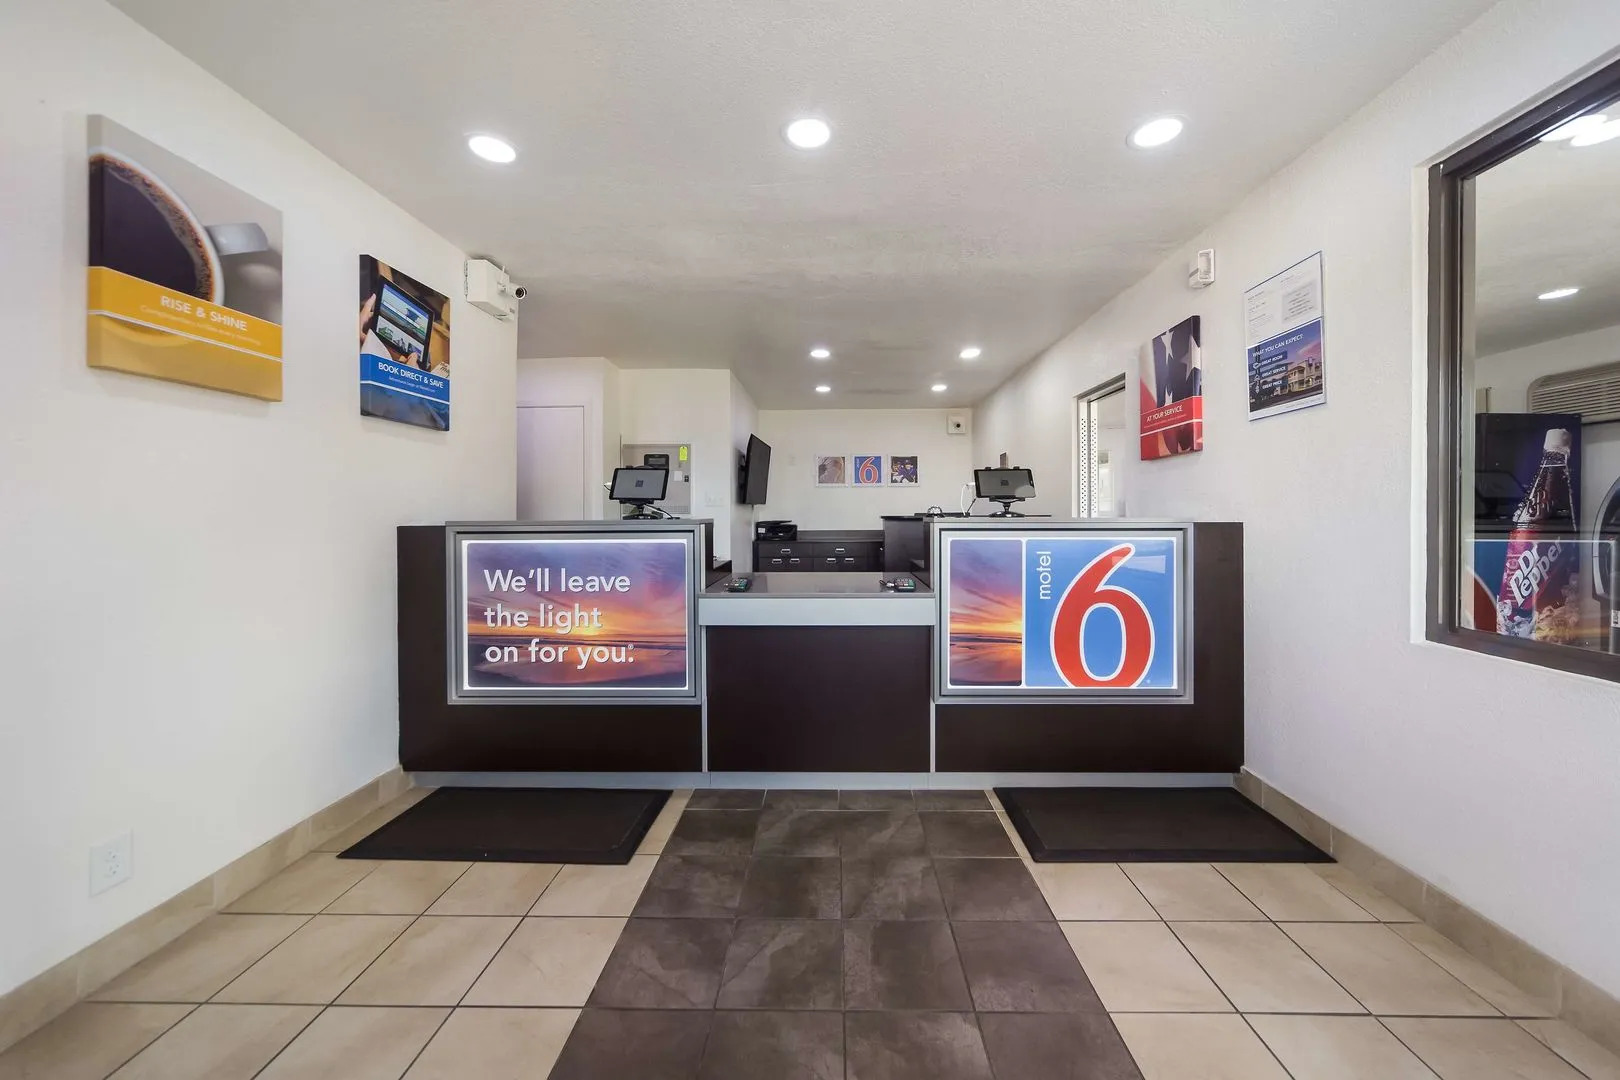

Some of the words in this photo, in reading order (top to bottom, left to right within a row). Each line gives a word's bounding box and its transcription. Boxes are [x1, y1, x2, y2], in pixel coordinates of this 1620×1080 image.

[160, 295, 192, 314] RISE
[196, 307, 206, 318] &
[210, 311, 248, 332] SHINE
[1264, 345, 1275, 353] YOU
[1274, 340, 1285, 349] CAN
[378, 362, 399, 375] BOOK
[400, 369, 423, 382] DIRECT
[429, 378, 444, 389] SAVE
[1152, 411, 1164, 420] YOUR
[1164, 404, 1183, 416] SERVICE
[859, 457, 878, 485] 6
[1509, 536, 1563, 607] Pepper
[1518, 541, 1541, 576] Dr
[484, 568, 550, 592] We’ll
[560, 568, 631, 592] leave
[1036, 551, 1051, 600] motel
[484, 603, 529, 627] the
[539, 603, 602, 634] light
[1050, 542, 1156, 689] 6
[485, 645, 519, 663] on
[528, 638, 568, 663] for
